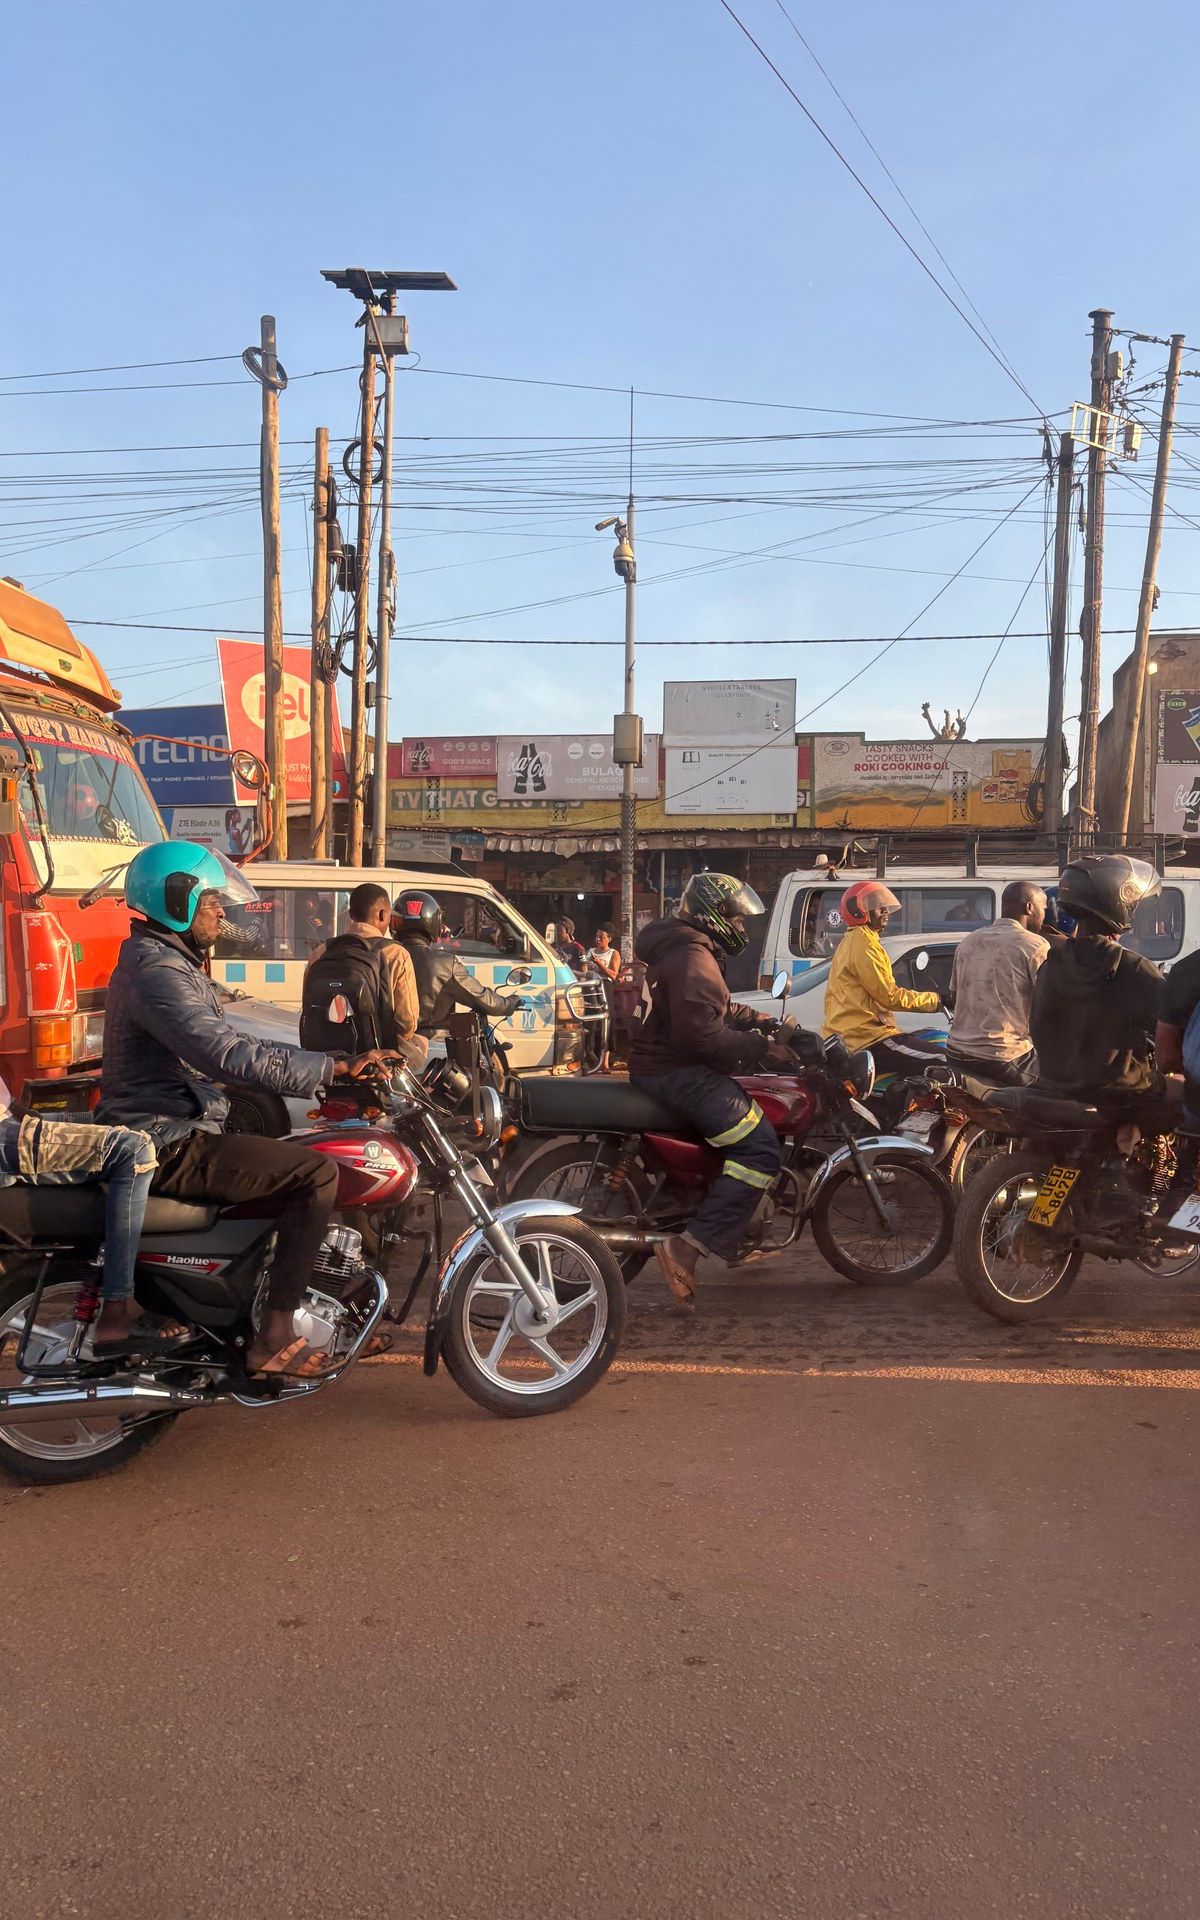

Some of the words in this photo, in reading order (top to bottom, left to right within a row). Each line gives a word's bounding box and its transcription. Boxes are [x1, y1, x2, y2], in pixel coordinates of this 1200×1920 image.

[258, 684, 308, 722] iel
[136, 735, 230, 765] TECNO
[865, 745, 893, 753] TASTY
[895, 744, 934, 752] SNACKS
[865, 754, 906, 762] COOKED
[908, 753, 933, 761] WITH
[854, 763, 879, 771] ROKI
[881, 762, 932, 771] COOKING
[933, 762, 950, 770] OIL
[394, 791, 421, 808] TV
[425, 790, 478, 808] THAT
[178, 819, 189, 827] ZTE
[190, 819, 207, 827] Blade
[1049, 1170, 1077, 1208] 867B
[167, 1255, 210, 1266] Haojue
